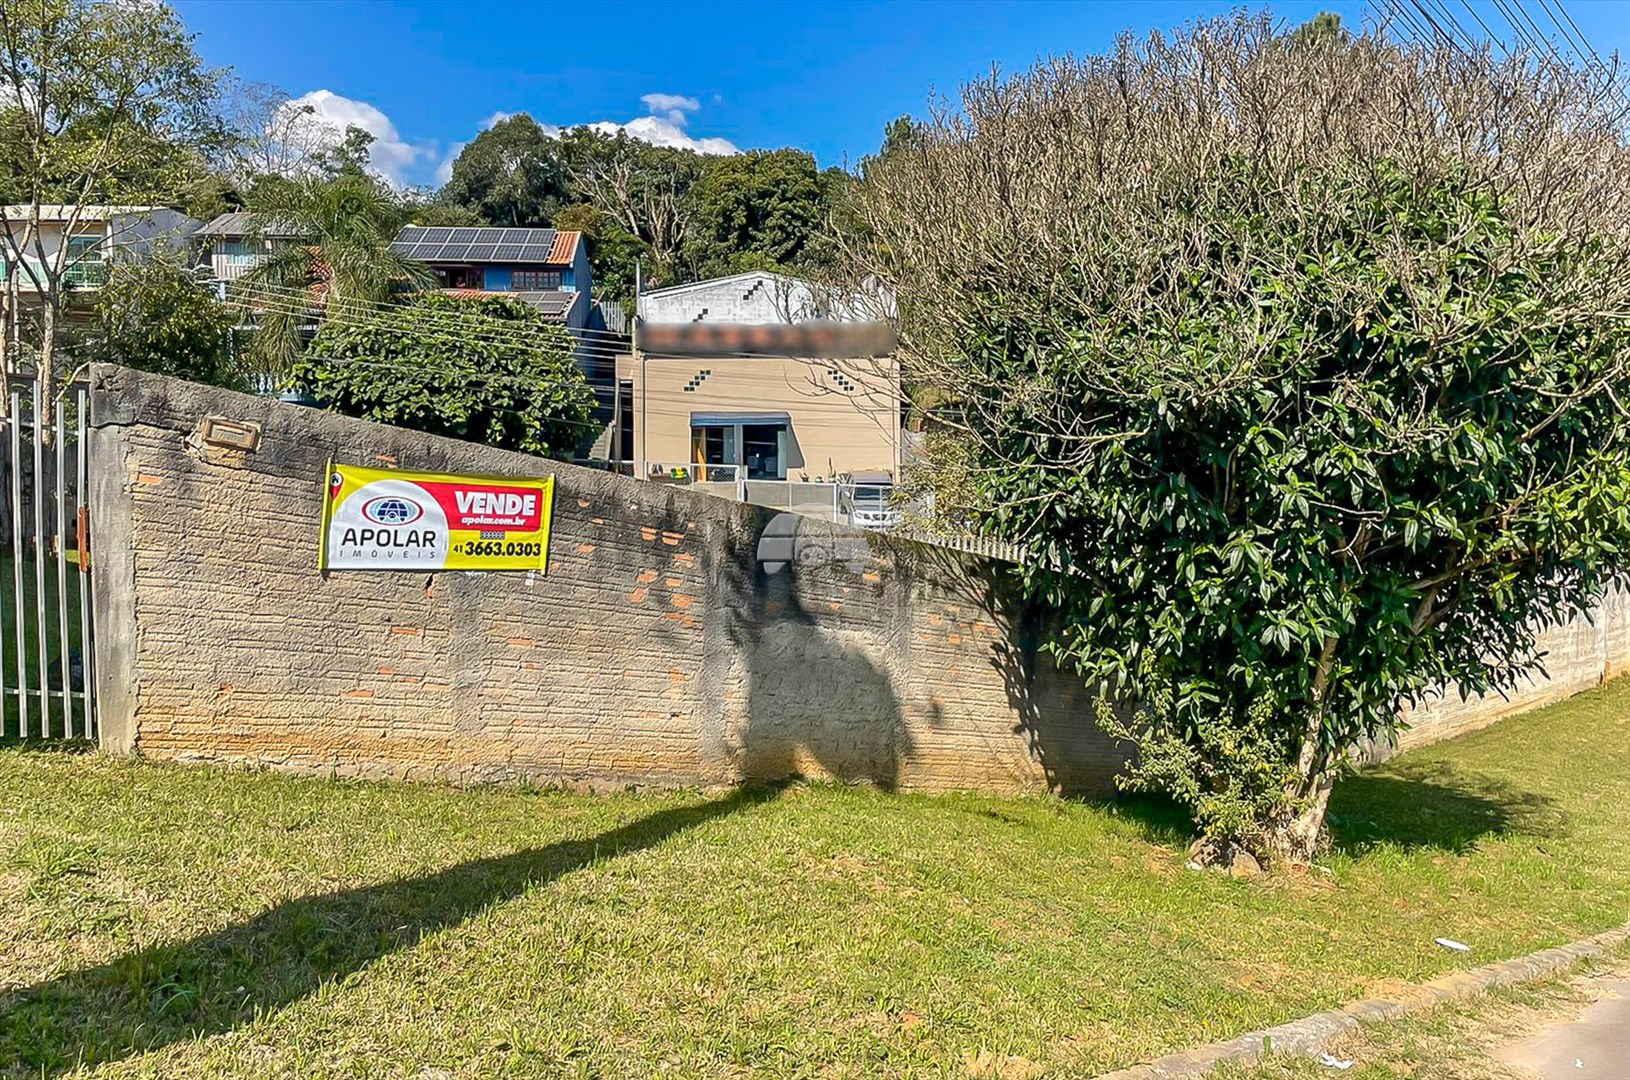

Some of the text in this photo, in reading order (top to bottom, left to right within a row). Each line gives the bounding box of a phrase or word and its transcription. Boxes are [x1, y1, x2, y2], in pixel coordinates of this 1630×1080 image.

[454, 491, 536, 516] VENDE
[341, 528, 435, 548] APOLAR
[340, 549, 435, 559] IMÓVEIS
[453, 544, 463, 553] 41
[464, 541, 541, 556] 3663.0303
